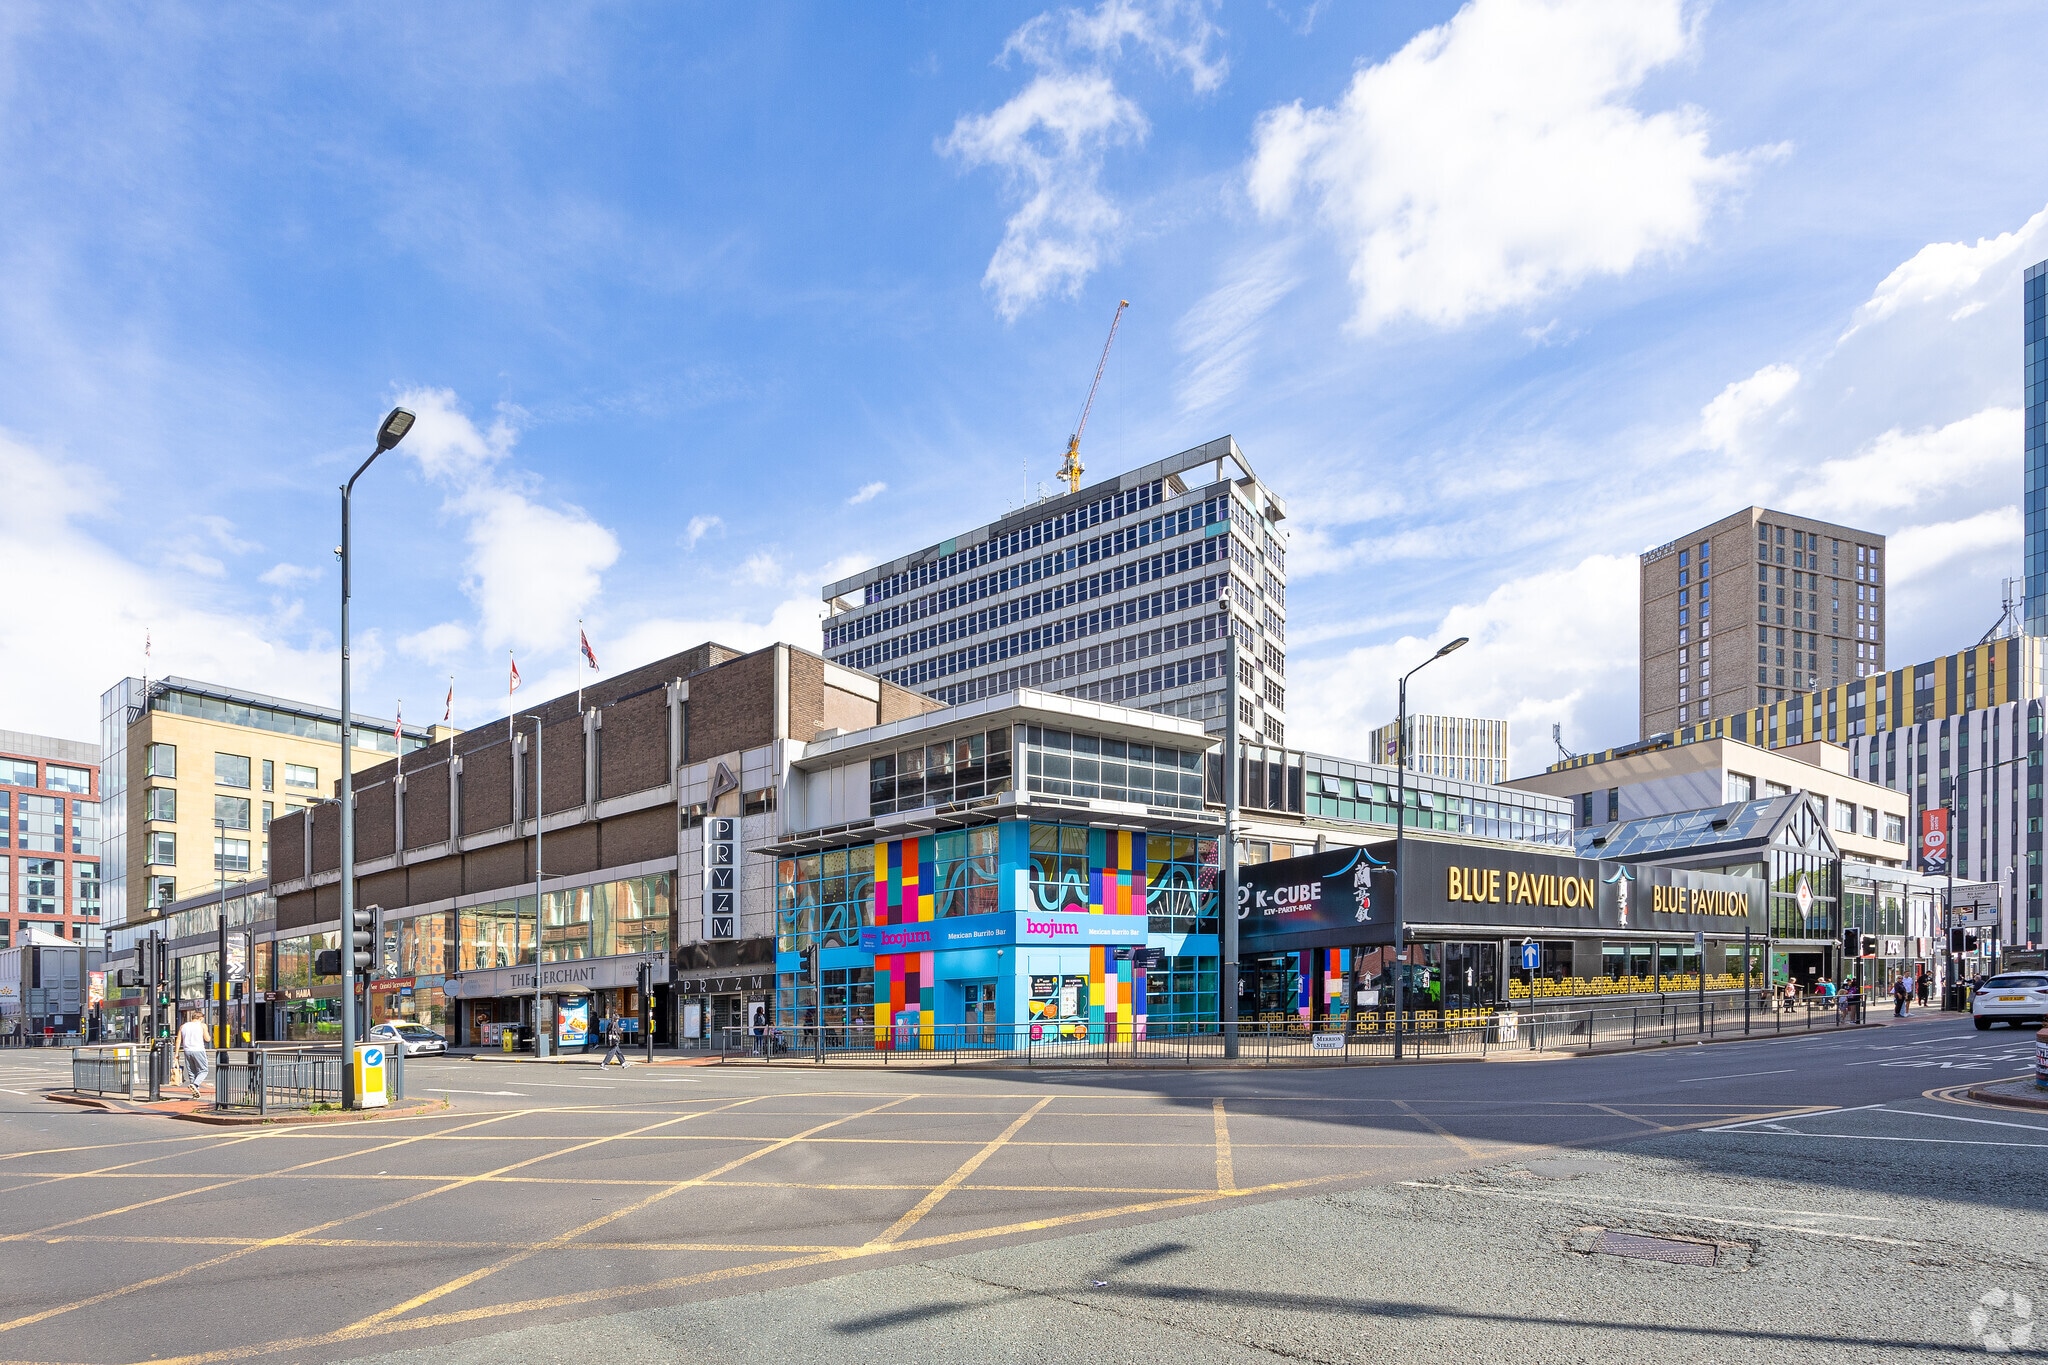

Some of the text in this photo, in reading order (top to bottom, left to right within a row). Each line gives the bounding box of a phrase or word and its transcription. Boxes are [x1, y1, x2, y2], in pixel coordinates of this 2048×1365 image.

[714, 820, 732, 936] PRYZM
[1448, 866, 1594, 909] BLUE PAVILION
[1256, 882, 1321, 908] K-CUBE
[1653, 884, 1748, 917] BLUE PAVILION
[1026, 918, 1078, 938] boojum
[881, 929, 931, 948] boojum
[1886, 940, 1900, 954] KFC
[511, 974, 530, 986] THE
[684, 976, 762, 993] PRYZM
